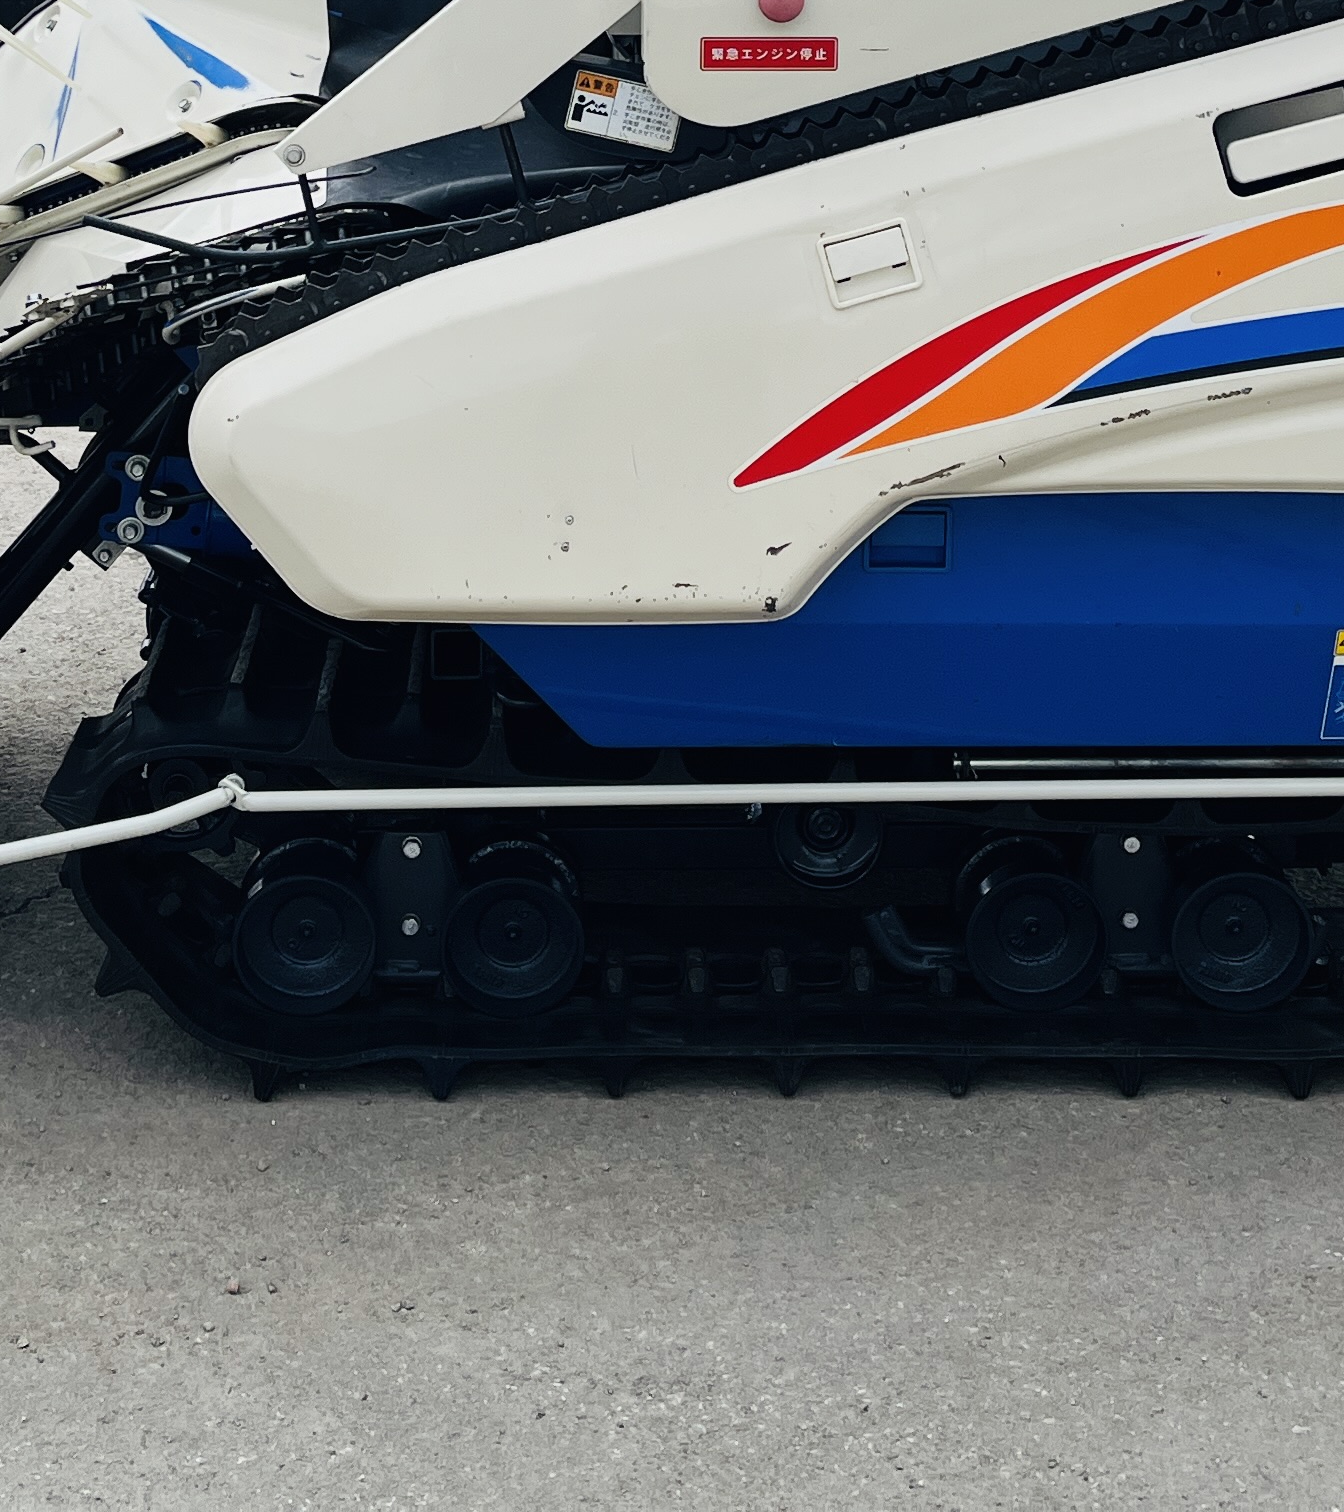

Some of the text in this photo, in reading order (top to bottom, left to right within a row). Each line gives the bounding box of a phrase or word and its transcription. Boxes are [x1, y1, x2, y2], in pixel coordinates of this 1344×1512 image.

[711, 47, 828, 61] 緊急エンジン停止
